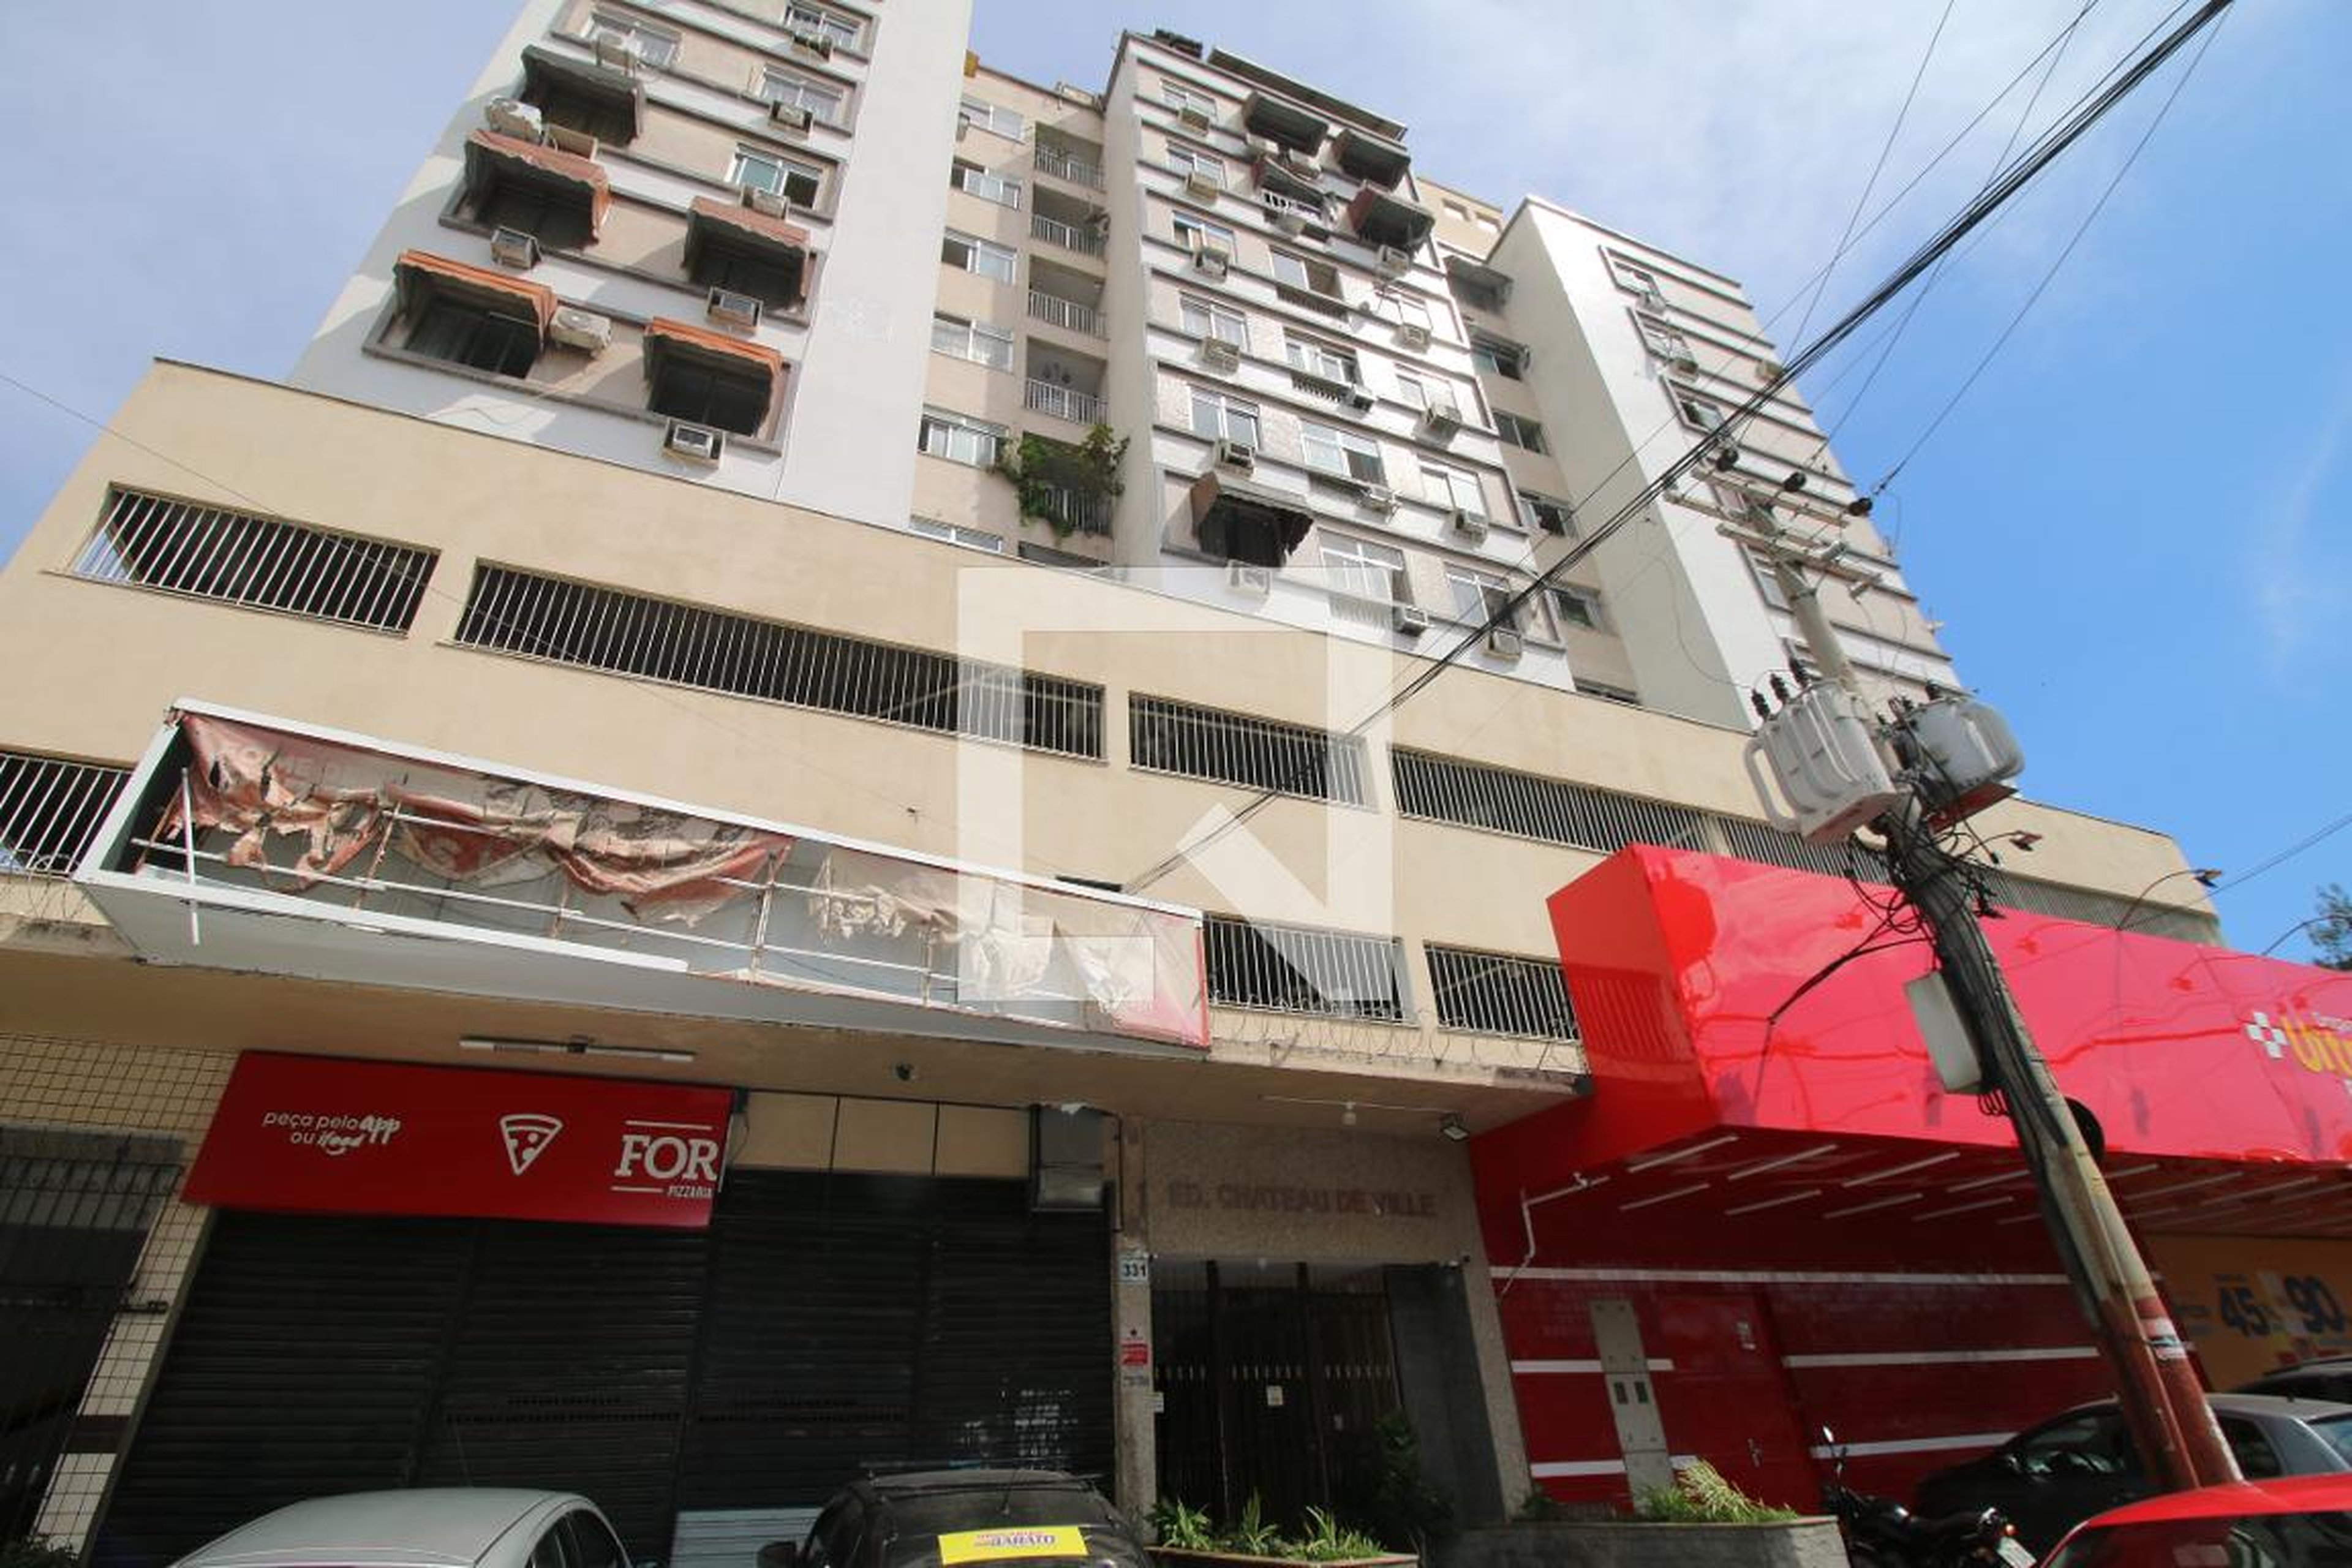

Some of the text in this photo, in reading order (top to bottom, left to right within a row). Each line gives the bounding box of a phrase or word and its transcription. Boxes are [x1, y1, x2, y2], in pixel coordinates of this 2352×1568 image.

[263, 1112, 314, 1128] peça
[315, 1115, 359, 1130] pelo
[291, 1133, 315, 1144] ou
[614, 1134, 719, 1182] FOR
[1123, 1264, 1146, 1276] 331
